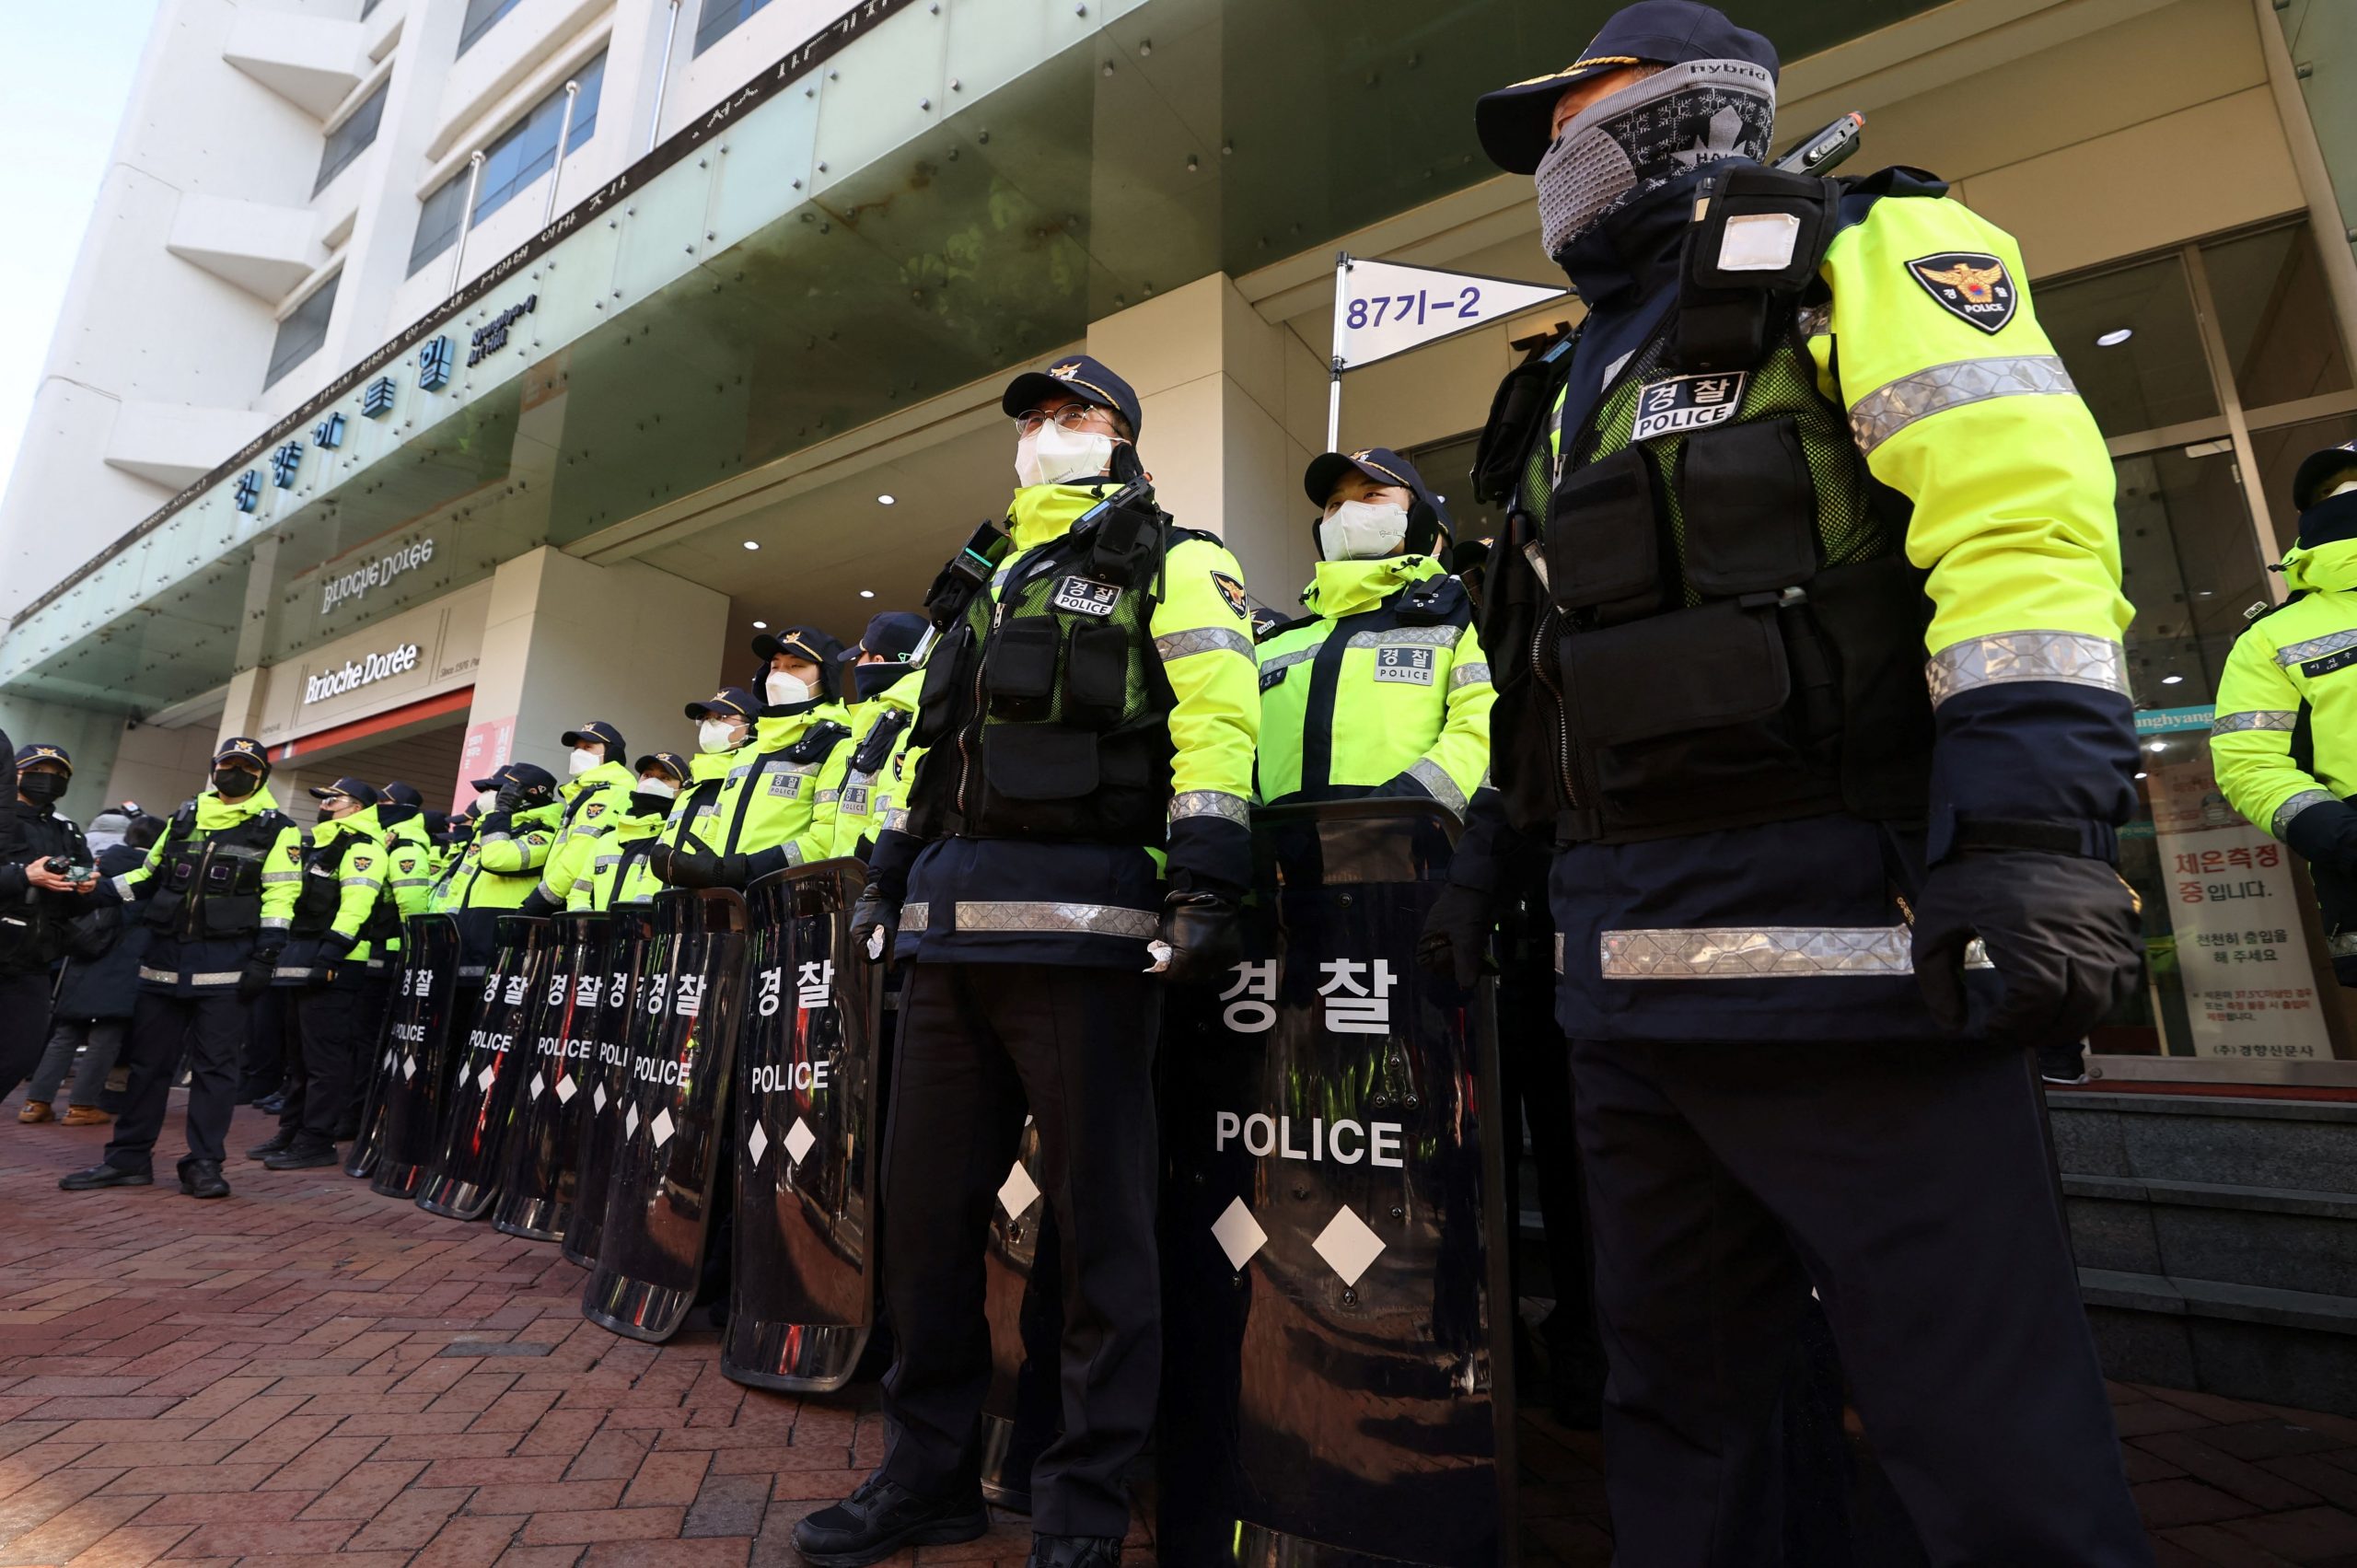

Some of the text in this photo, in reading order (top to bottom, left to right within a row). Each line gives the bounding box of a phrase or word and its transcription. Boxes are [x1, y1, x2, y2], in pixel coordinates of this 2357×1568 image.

[1689, 64, 1766, 82] hybrid
[1347, 286, 1481, 330] 87기-2
[1964, 303, 2005, 312] POLICE
[1640, 406, 1727, 436] POLICE
[1061, 597, 1108, 614] POLICE
[305, 644, 417, 704] Brioche Dorée
[1380, 669, 1427, 679] POLICE
[2175, 844, 2280, 874] 체온측정
[469, 1029, 513, 1052] POLICE
[538, 1037, 592, 1059] POLICE
[633, 1055, 692, 1087] POLICE
[751, 1061, 829, 1094] POLICE
[1216, 1110, 1403, 1167] POLICE
